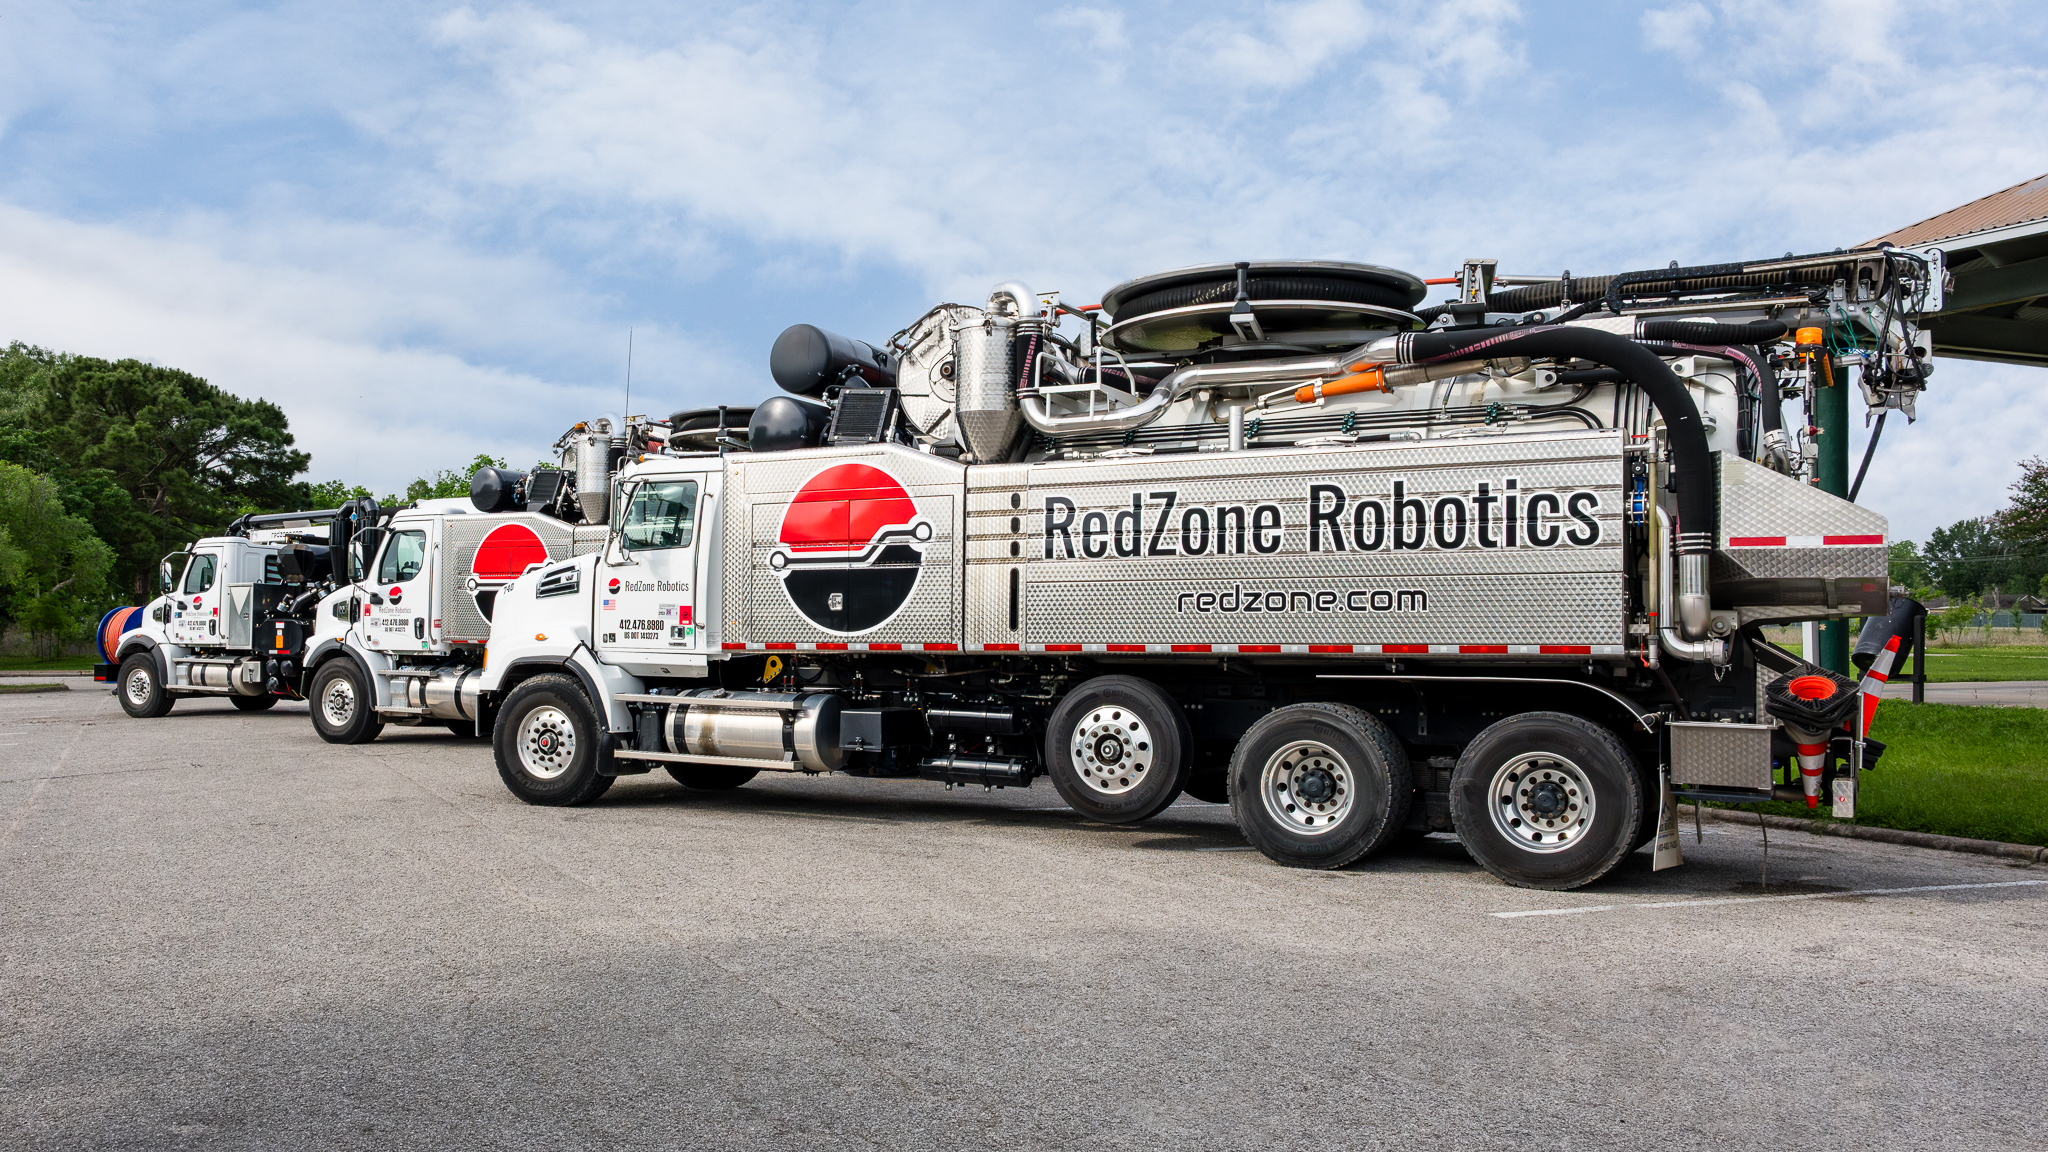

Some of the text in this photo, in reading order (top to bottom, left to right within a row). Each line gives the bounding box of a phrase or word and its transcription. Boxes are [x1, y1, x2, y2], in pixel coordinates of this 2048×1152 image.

[1044, 478, 1600, 559] RedZone Robotics
[625, 581, 689, 592] RedZone Robotics
[1177, 584, 1428, 613] redzone.com
[619, 619, 665, 631] 412.476.8980
[624, 632, 630, 640] US
[631, 632, 639, 640] DOT
